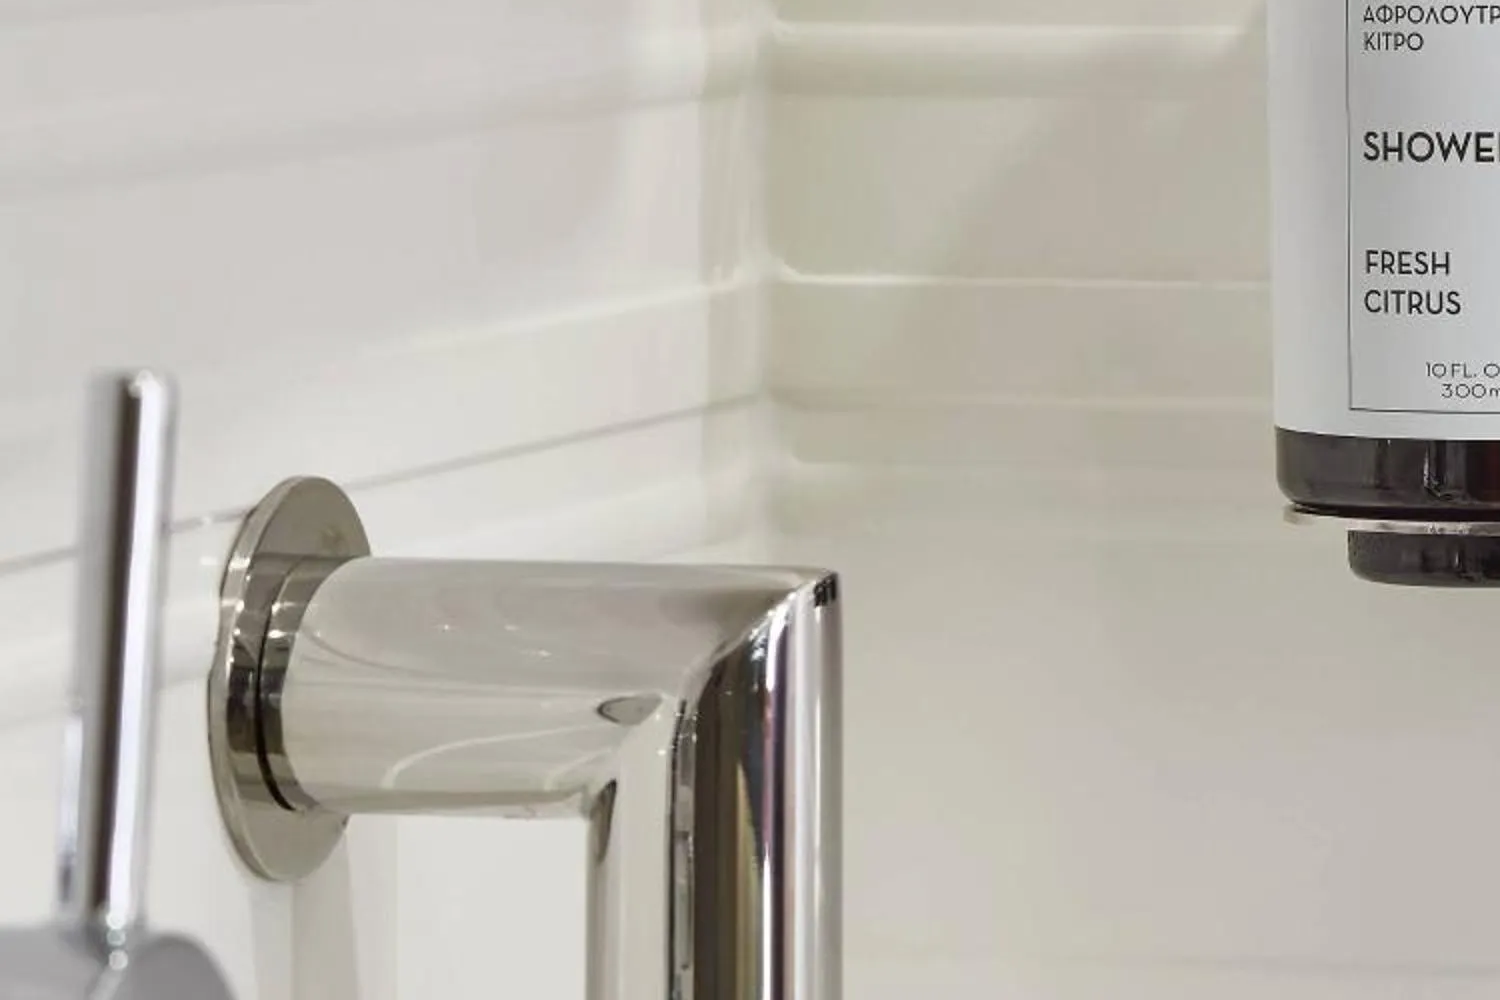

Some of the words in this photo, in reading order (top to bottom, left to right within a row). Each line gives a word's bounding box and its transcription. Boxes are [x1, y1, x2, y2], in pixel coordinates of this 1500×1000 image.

[1363, 31, 1424, 51] ΚΙΤΡΟ
[1364, 250, 1451, 276] FRESH
[1363, 289, 1462, 316] CITRUS
